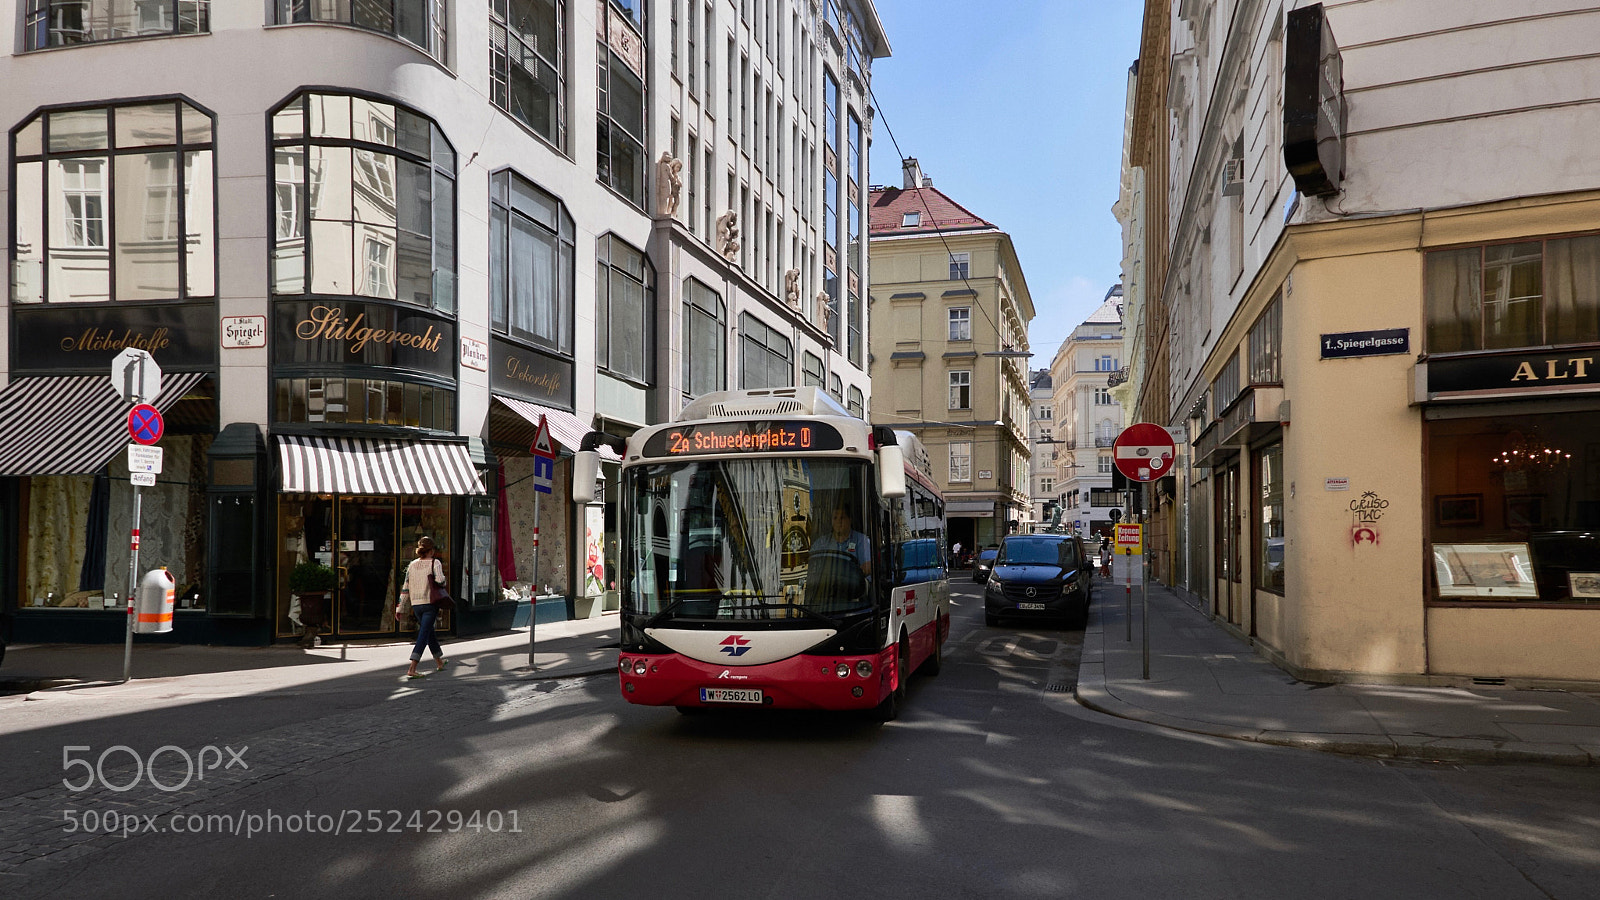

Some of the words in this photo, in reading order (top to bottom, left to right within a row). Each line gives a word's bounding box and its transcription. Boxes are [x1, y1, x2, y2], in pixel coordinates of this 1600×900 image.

[60, 327, 170, 356] Möbelstoffe
[296, 306, 443, 354] Stilgerecht
[505, 355, 560, 396] Dekorstoffe
[1510, 357, 1593, 382] ALT
[670, 432, 690, 452] 2A
[694, 428, 796, 450] Schwedenplatz
[133, 474, 153, 484] Anfang
[1118, 527, 1139, 535] Kronen
[707, 690, 715, 700] W
[721, 690, 746, 701] 2562
